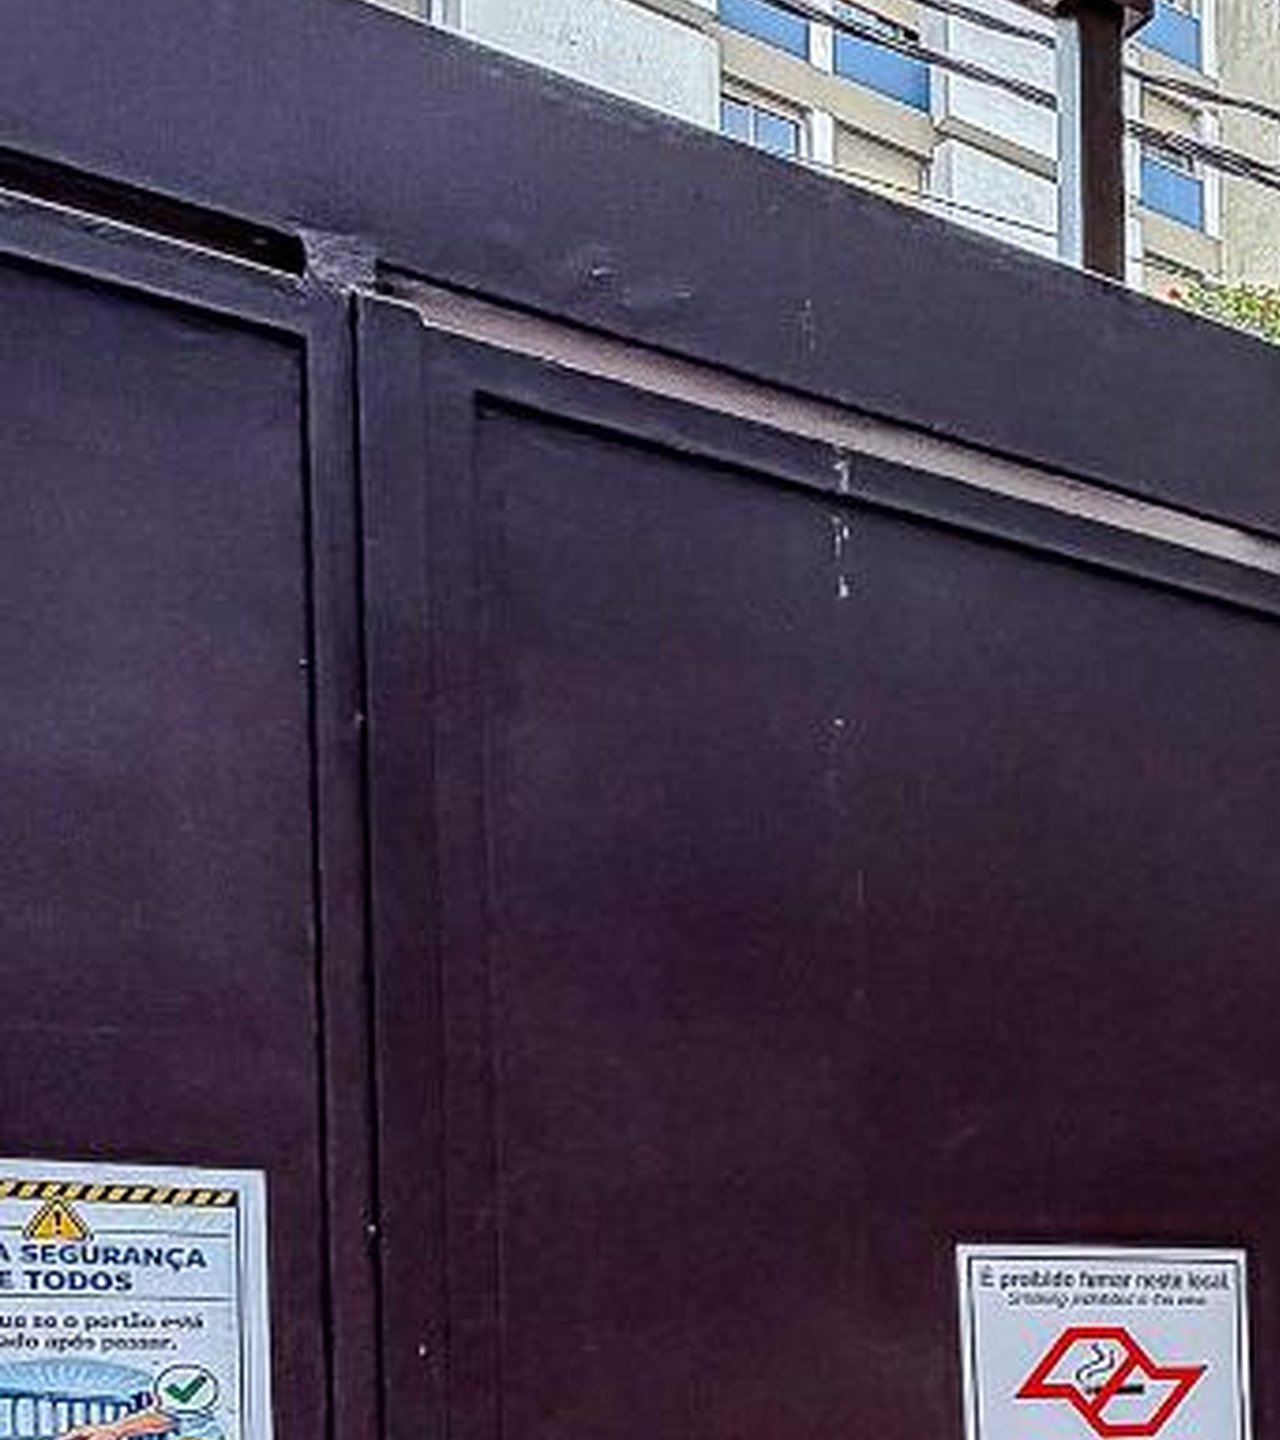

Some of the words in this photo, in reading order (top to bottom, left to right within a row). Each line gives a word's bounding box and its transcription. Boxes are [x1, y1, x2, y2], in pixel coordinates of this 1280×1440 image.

[20, 1244, 207, 1271] SEGURANÇA
[23, 1270, 133, 1291] TODOS
[1001, 1270, 1076, 1291] proibido
[84, 1311, 156, 1332] portão
